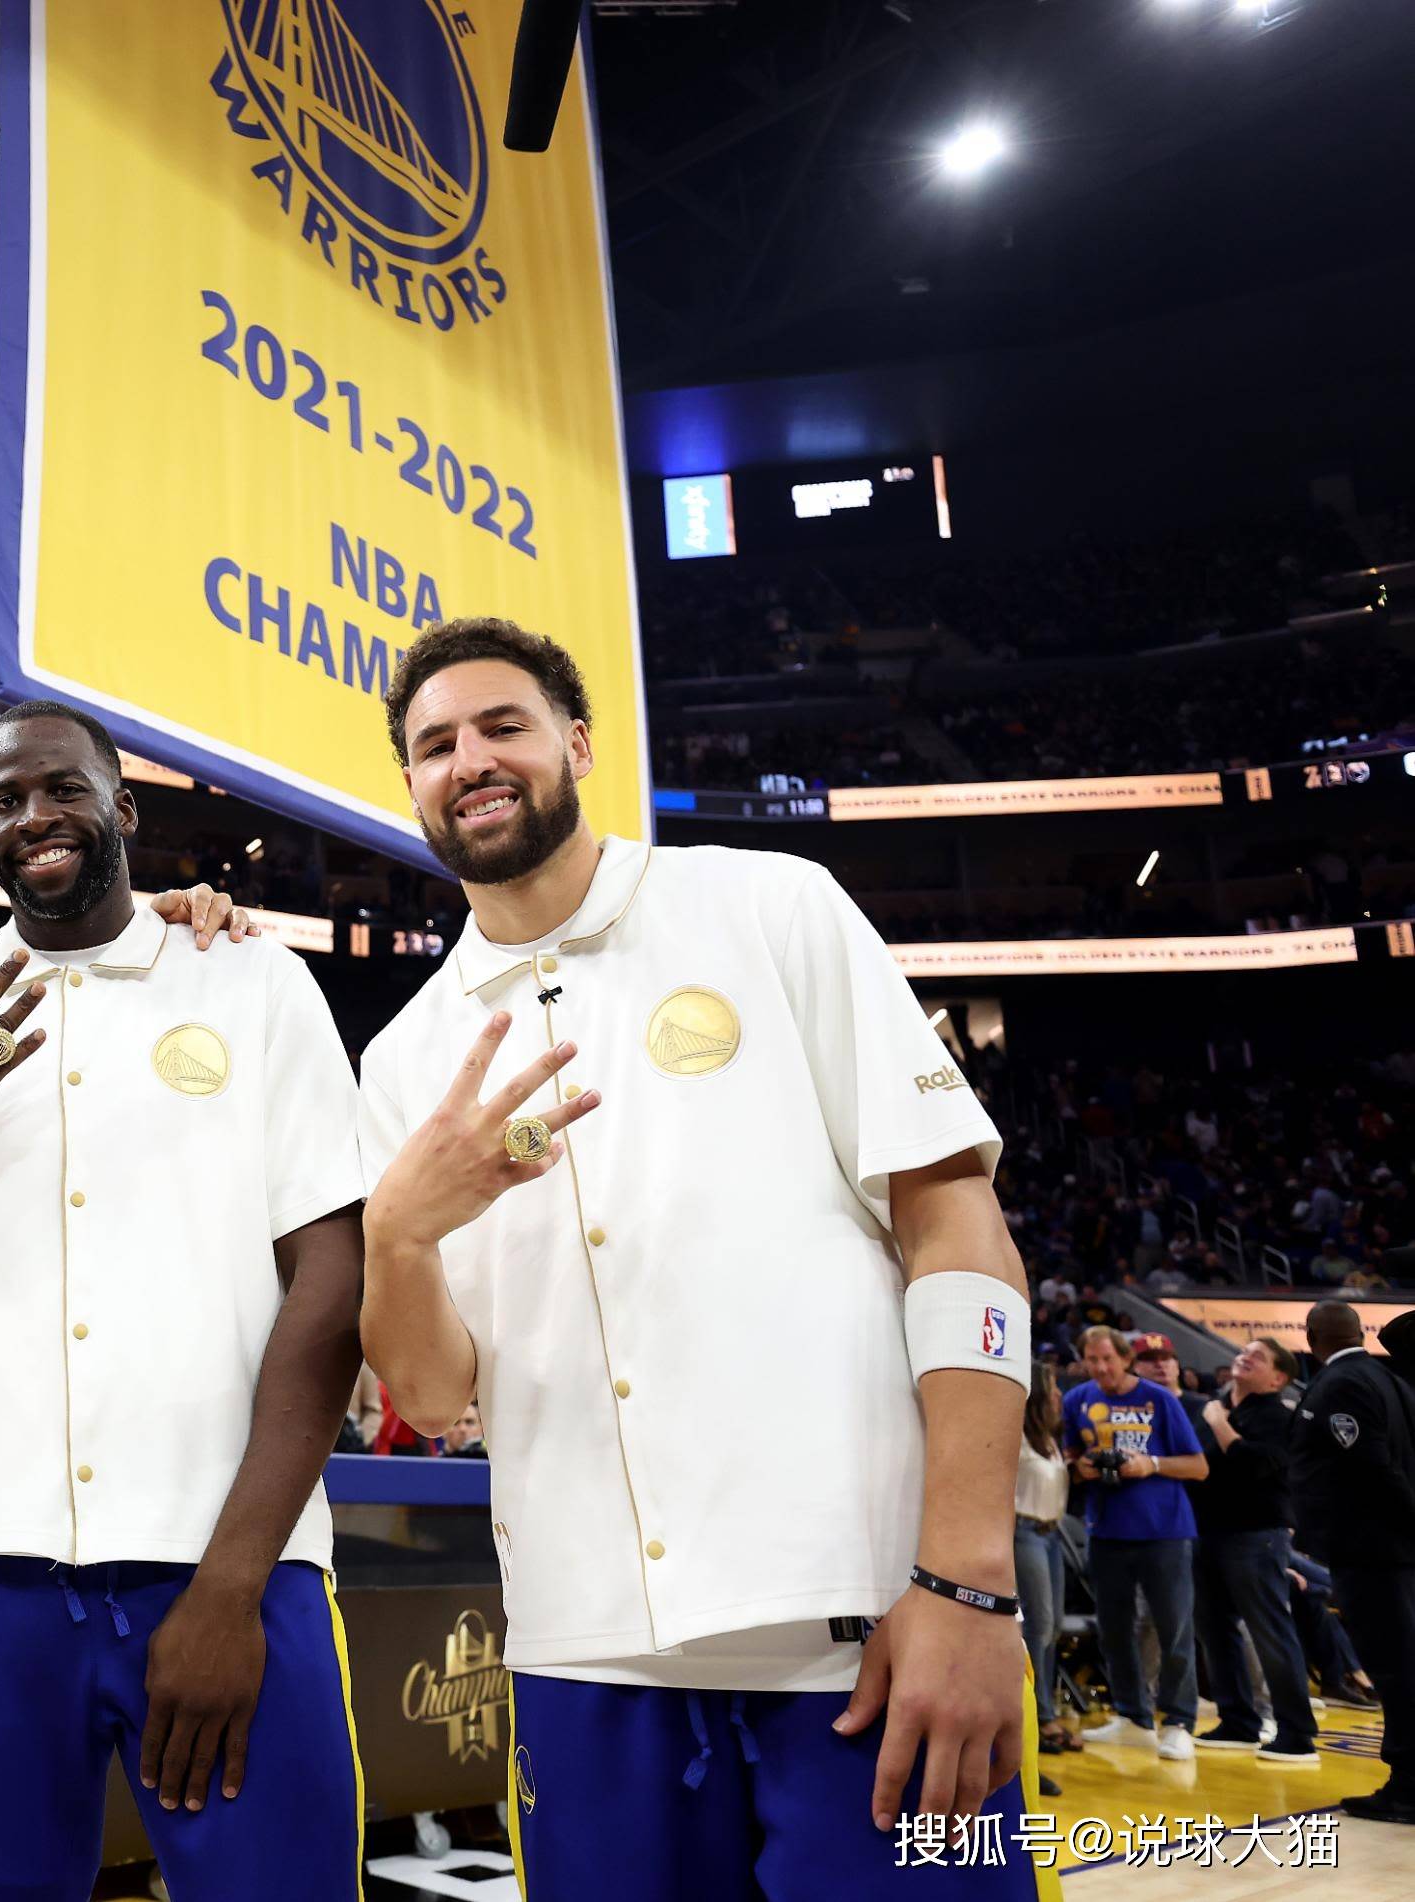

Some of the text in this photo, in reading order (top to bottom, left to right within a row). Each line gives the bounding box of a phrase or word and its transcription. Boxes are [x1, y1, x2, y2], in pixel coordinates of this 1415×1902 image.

[210, 45, 507, 331] WARRIORS
[201, 290, 538, 560] 2021-2022
[203, 556, 409, 704] CHAM
[330, 521, 443, 630] NBA
